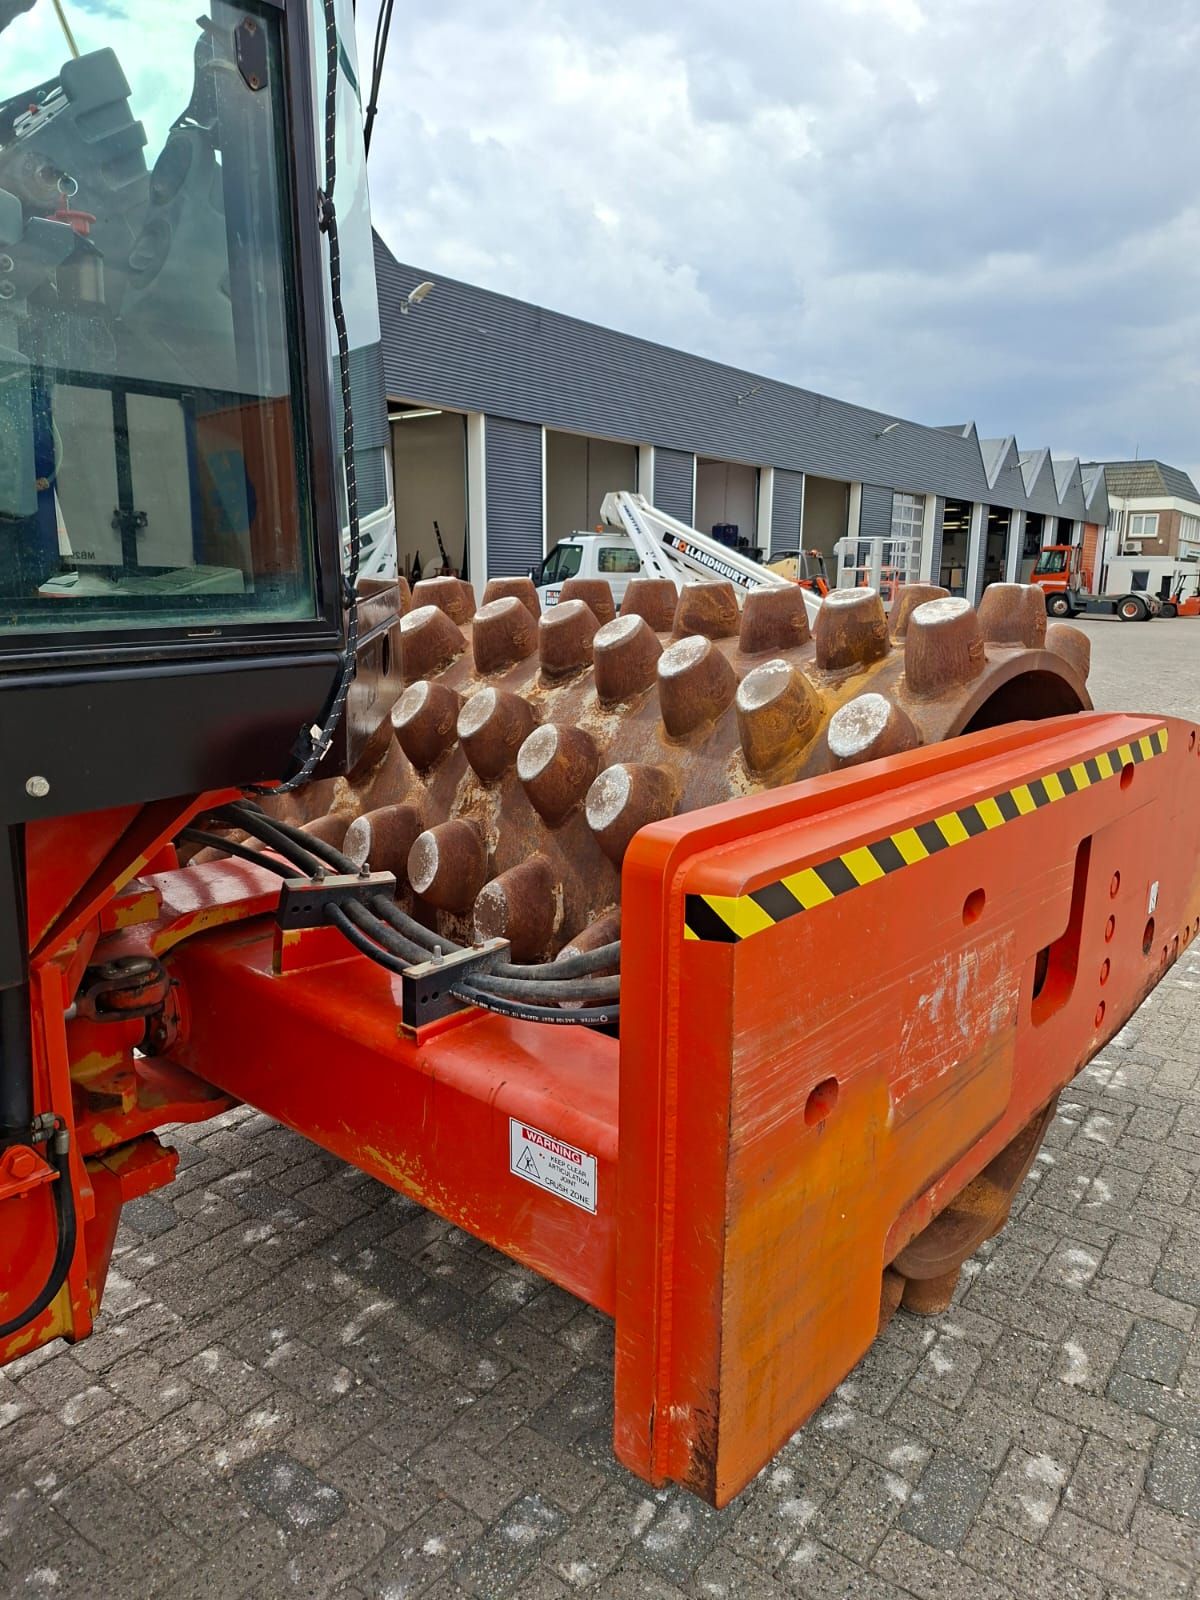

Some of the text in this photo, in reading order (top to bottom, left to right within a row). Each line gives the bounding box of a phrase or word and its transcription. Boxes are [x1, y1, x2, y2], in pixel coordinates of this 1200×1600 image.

[526, 1130, 580, 1164] WARNING
[548, 1162, 590, 1187] ARTICULATION
[550, 1155, 587, 1178] KEEP CLEAR
[545, 1177, 591, 1206] CRUSH ZONE
[560, 1176, 577, 1187] JOINT
